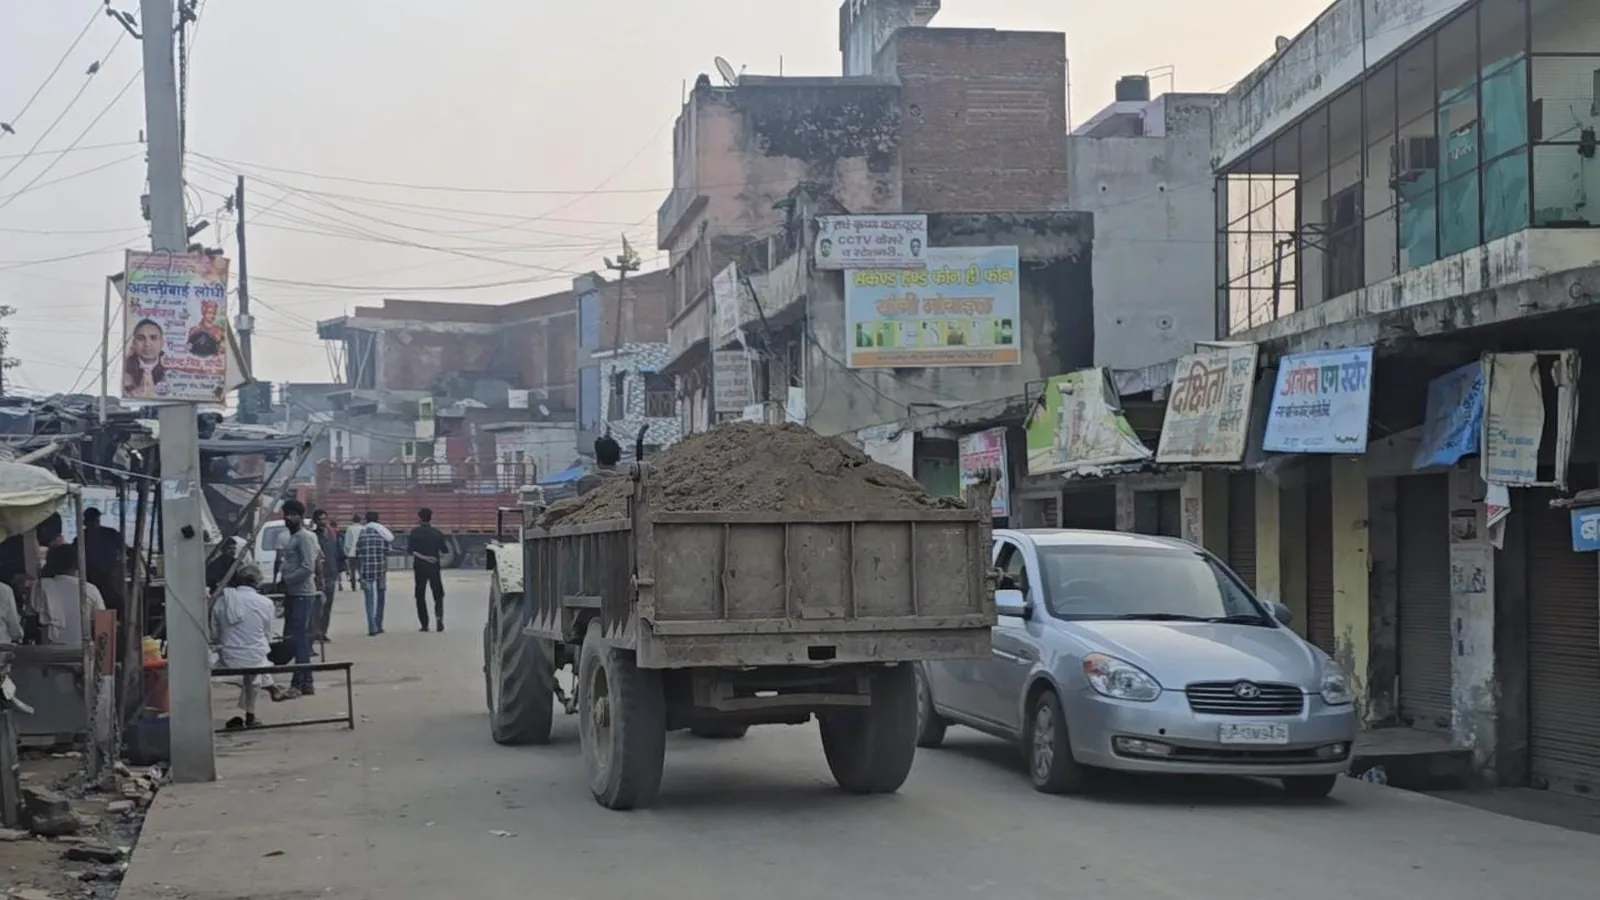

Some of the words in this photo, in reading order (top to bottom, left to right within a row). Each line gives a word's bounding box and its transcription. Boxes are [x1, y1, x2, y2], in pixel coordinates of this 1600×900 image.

[838, 235, 872, 245] CCTV
[194, 284, 225, 298] लोधी
[1341, 354, 1369, 392] स्टोर
